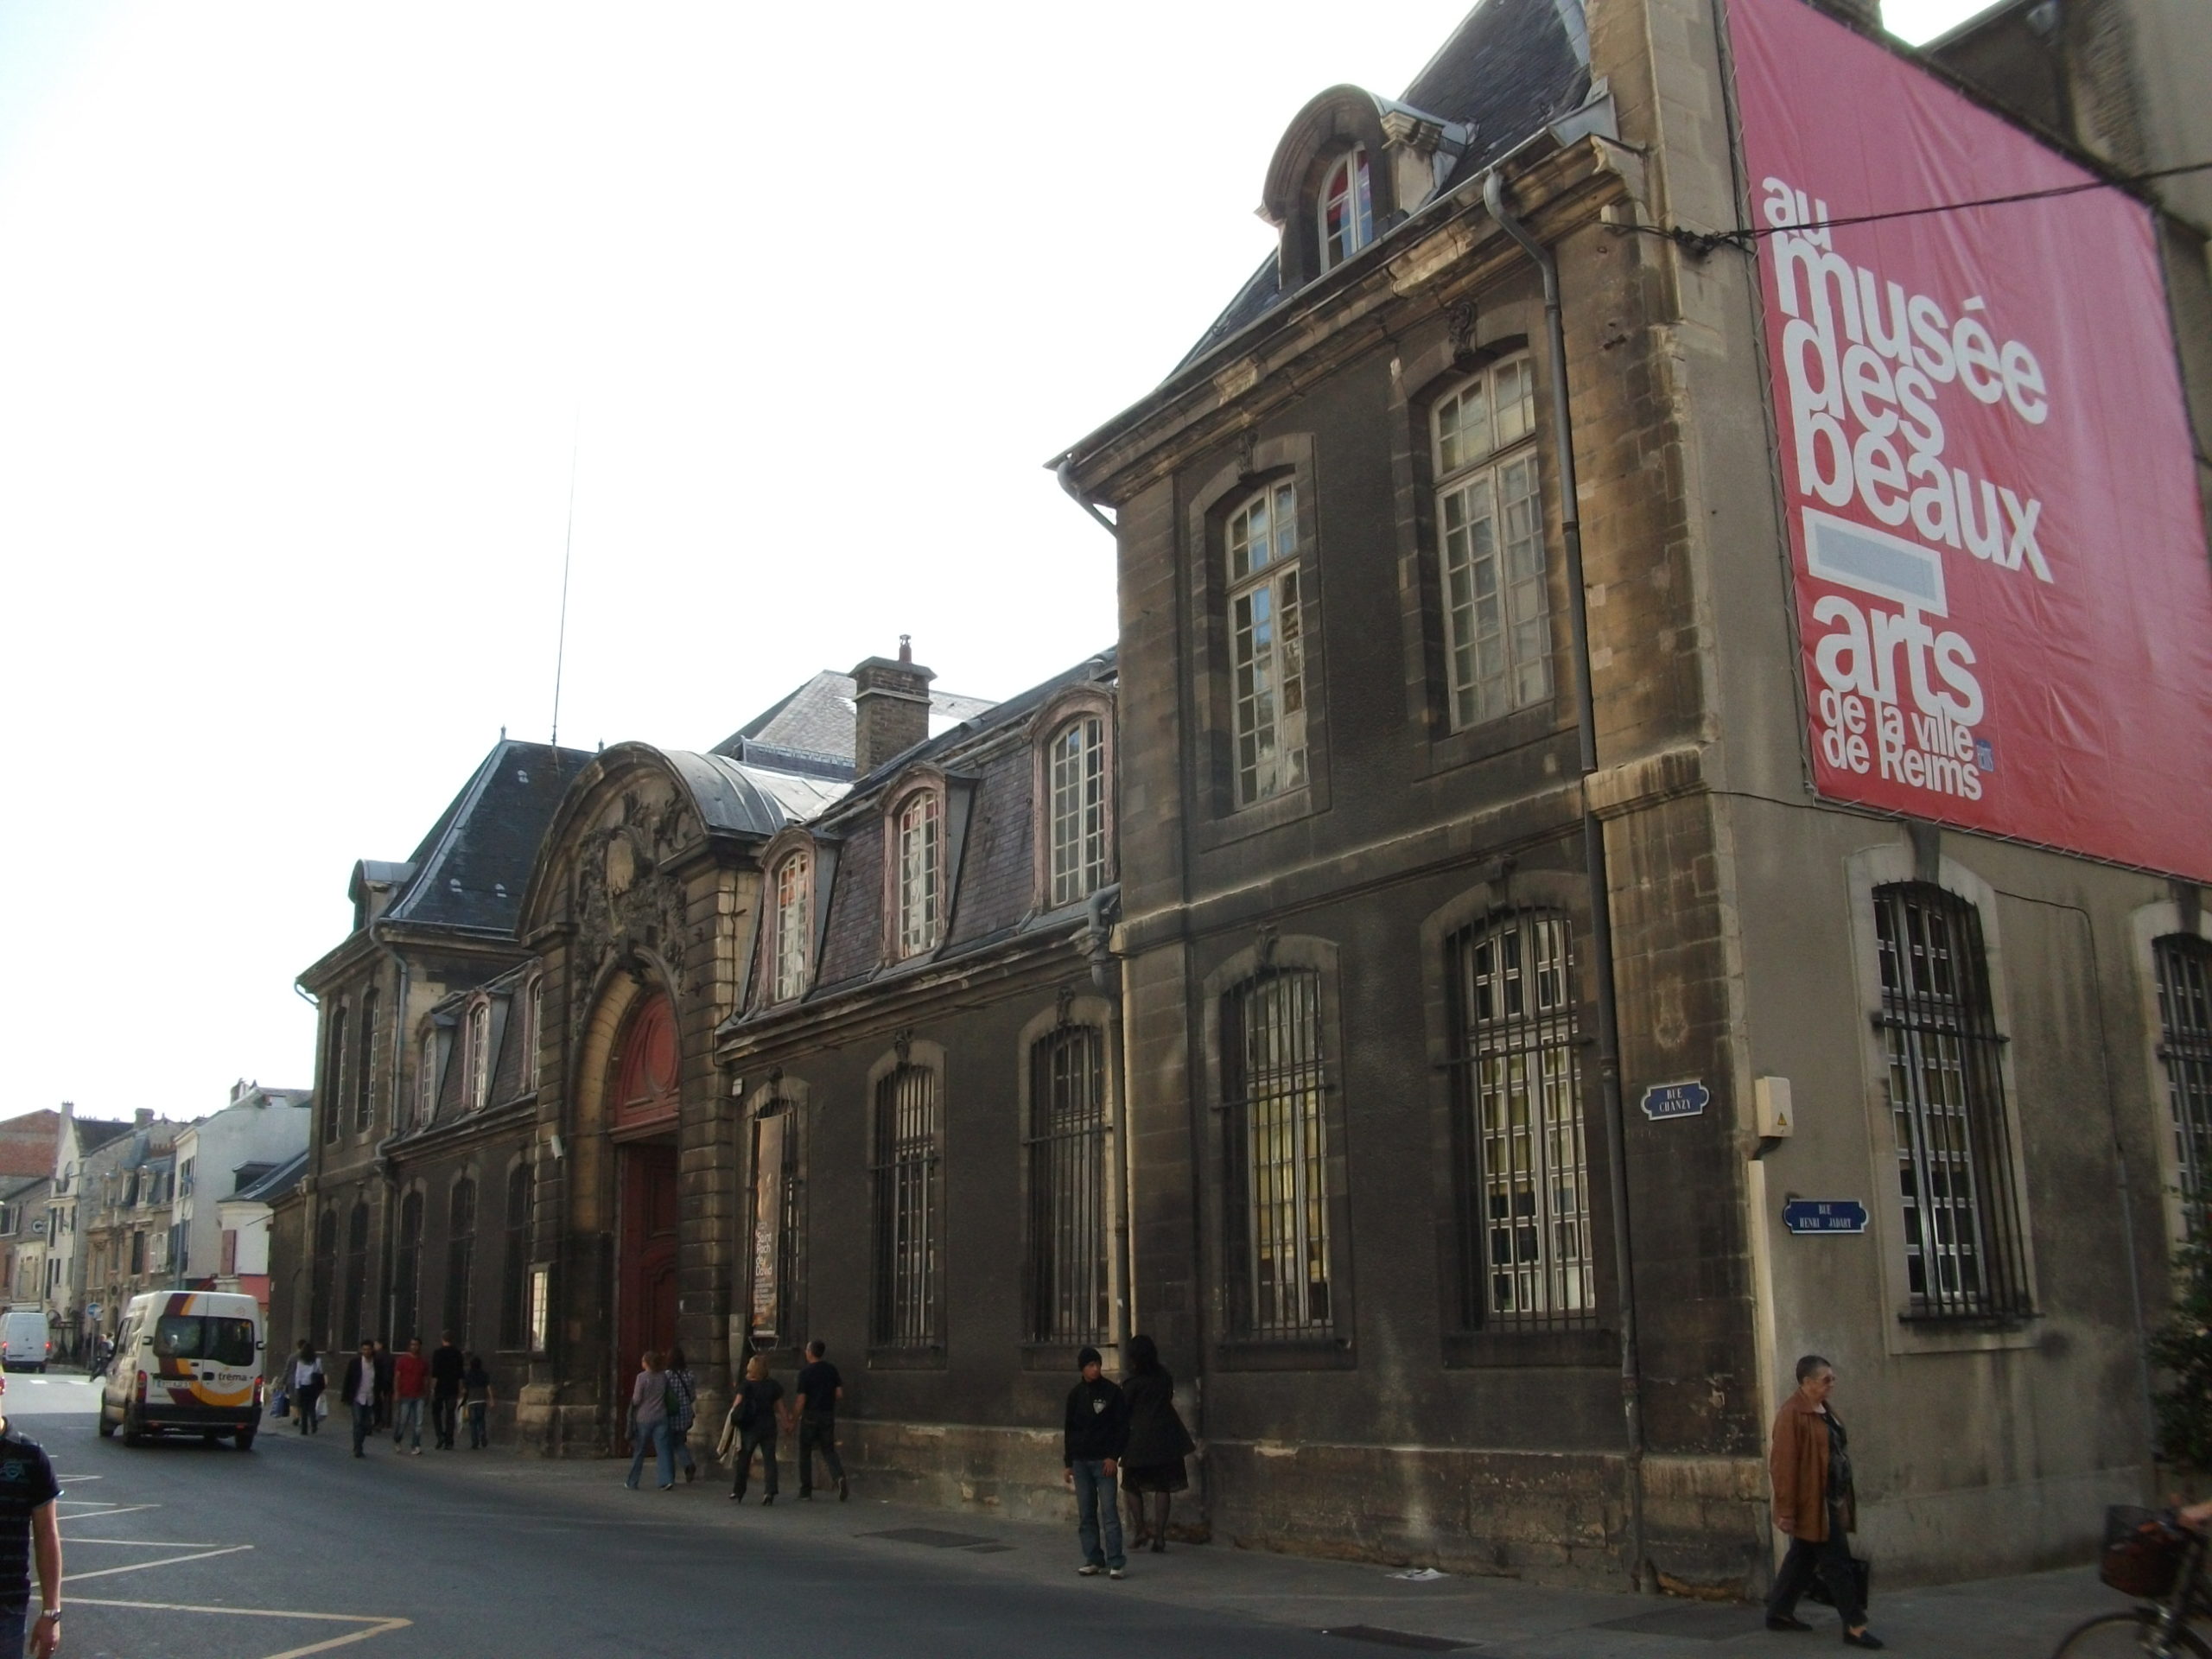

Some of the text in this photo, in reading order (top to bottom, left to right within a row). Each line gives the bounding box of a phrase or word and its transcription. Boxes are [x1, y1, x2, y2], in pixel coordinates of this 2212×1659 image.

[1762, 176, 1832, 251] au
[1771, 228, 2049, 425] musée
[1783, 304, 1945, 458] des
[1788, 380, 2055, 585] beaux
[1813, 594, 1985, 727] arts
[1819, 688, 1867, 734] de
[1872, 690, 1906, 746] la
[1910, 693, 1975, 762] ville
[1822, 721, 1870, 774] de
[1878, 736, 1983, 801] Reims
[1659, 1099, 1691, 1112] CHANZY
[1667, 1088, 1682, 1100] RUE
[1799, 1217, 1820, 1228] HENRI
[1818, 1204, 1832, 1215] RUE
